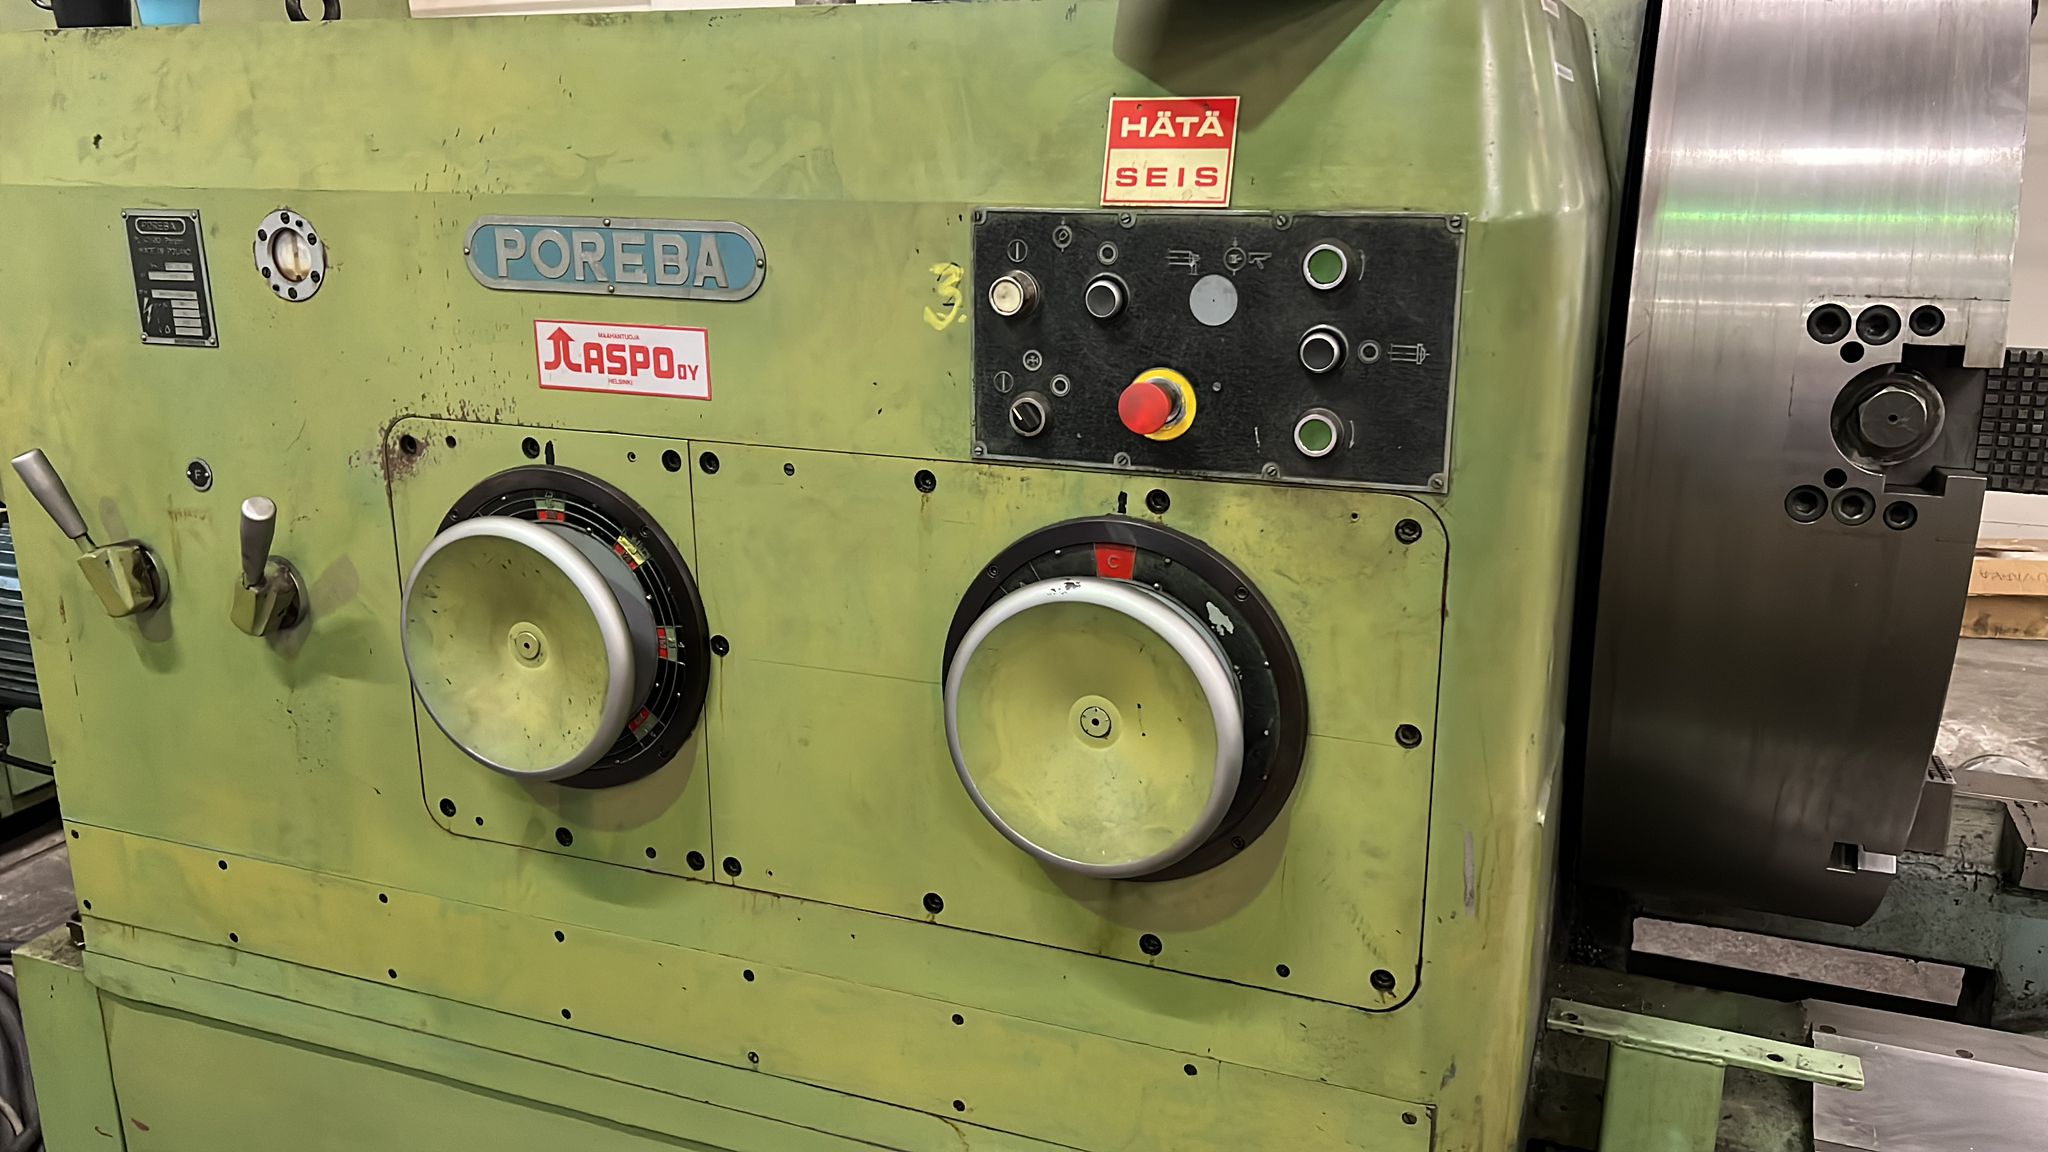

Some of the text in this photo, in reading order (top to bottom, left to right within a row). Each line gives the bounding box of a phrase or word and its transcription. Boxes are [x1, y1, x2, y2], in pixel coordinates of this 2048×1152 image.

[1120, 110, 1225, 138] HÄTÄ
[1115, 166, 1218, 187] SEIS
[597, 332, 640, 341] MAAHANTUOJA
[608, 378, 633, 386] HELSINKI
[1107, 554, 1120, 568] C
